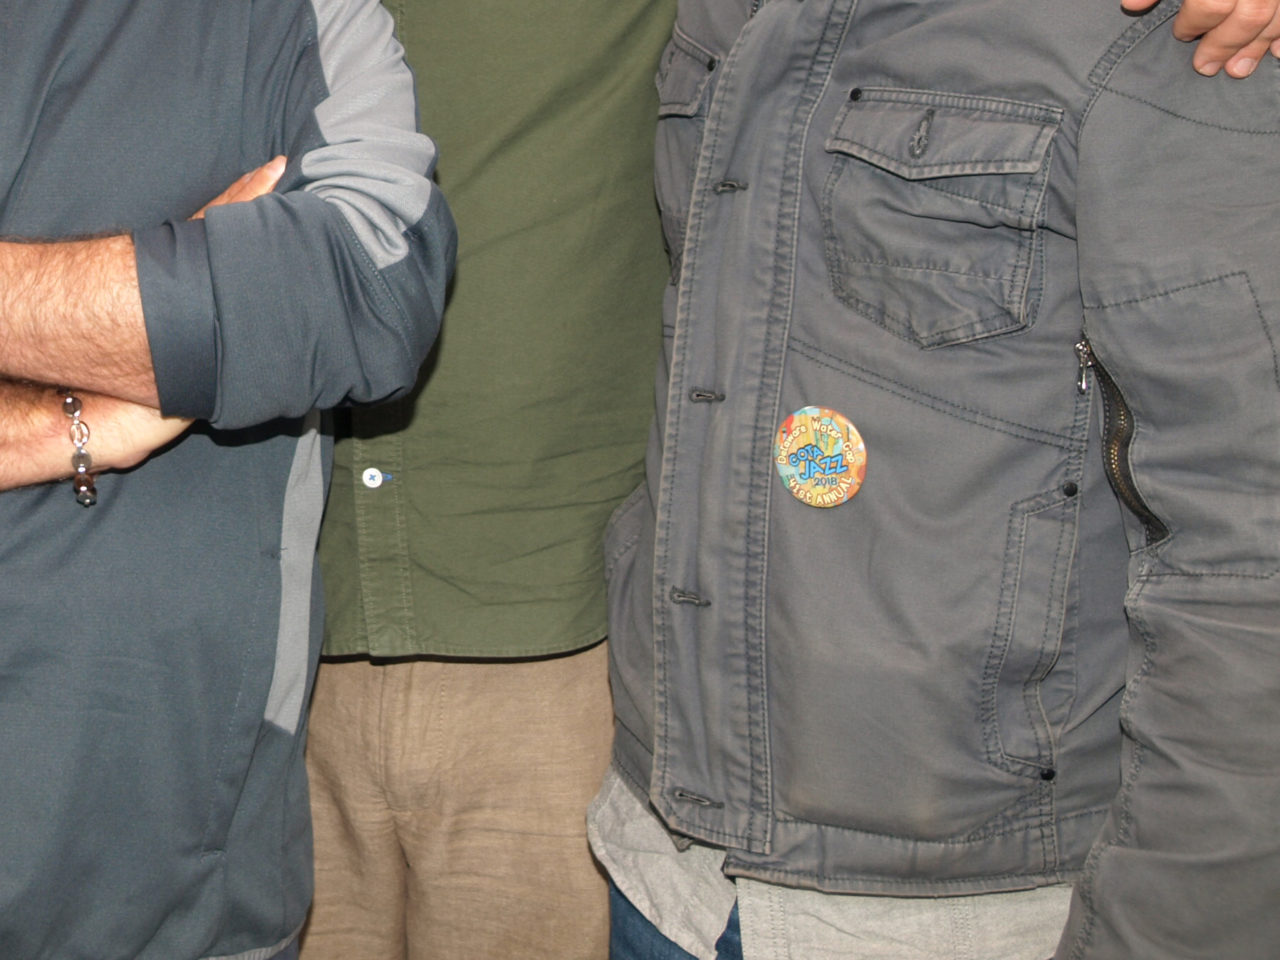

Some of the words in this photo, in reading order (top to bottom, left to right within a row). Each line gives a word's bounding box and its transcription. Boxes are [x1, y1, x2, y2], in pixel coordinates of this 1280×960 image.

[777, 425, 807, 464] Delaware
[811, 420, 842, 439] Water
[842, 441, 855, 464] Gap
[788, 443, 824, 467] COTA
[800, 453, 849, 480] JAZZ
[788, 478, 813, 503] 41st
[816, 477, 852, 505] ANNUAL
[813, 476, 838, 487] 2018
